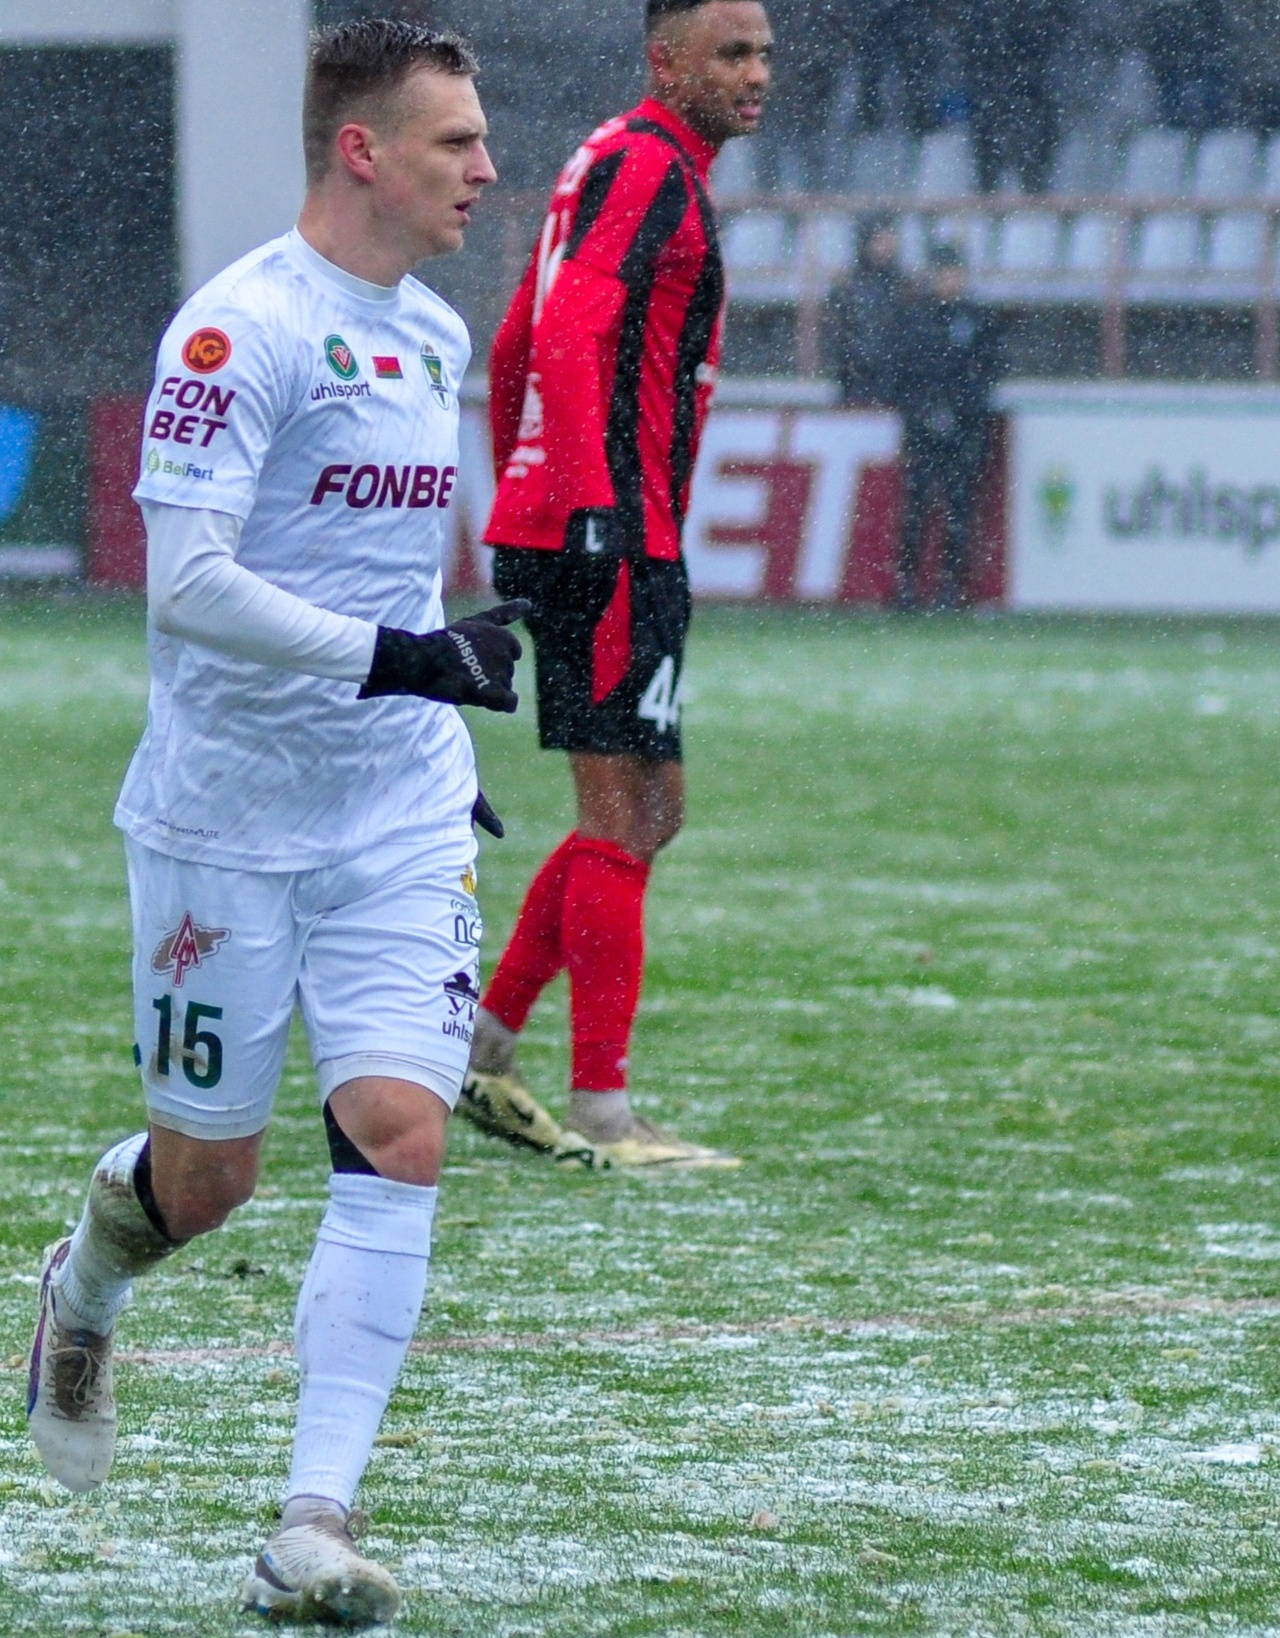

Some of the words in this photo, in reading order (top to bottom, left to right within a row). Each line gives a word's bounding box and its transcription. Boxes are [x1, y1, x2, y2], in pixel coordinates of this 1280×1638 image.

[157, 376, 236, 417] FON
[310, 380, 371, 402] uhlsport
[149, 410, 228, 448] BET
[163, 460, 214, 481] BelFert
[310, 464, 458, 509] FONBE
[447, 630, 491, 690] uhlsport
[152, 994, 223, 1089] 15
[442, 1020, 472, 1046] uhls
